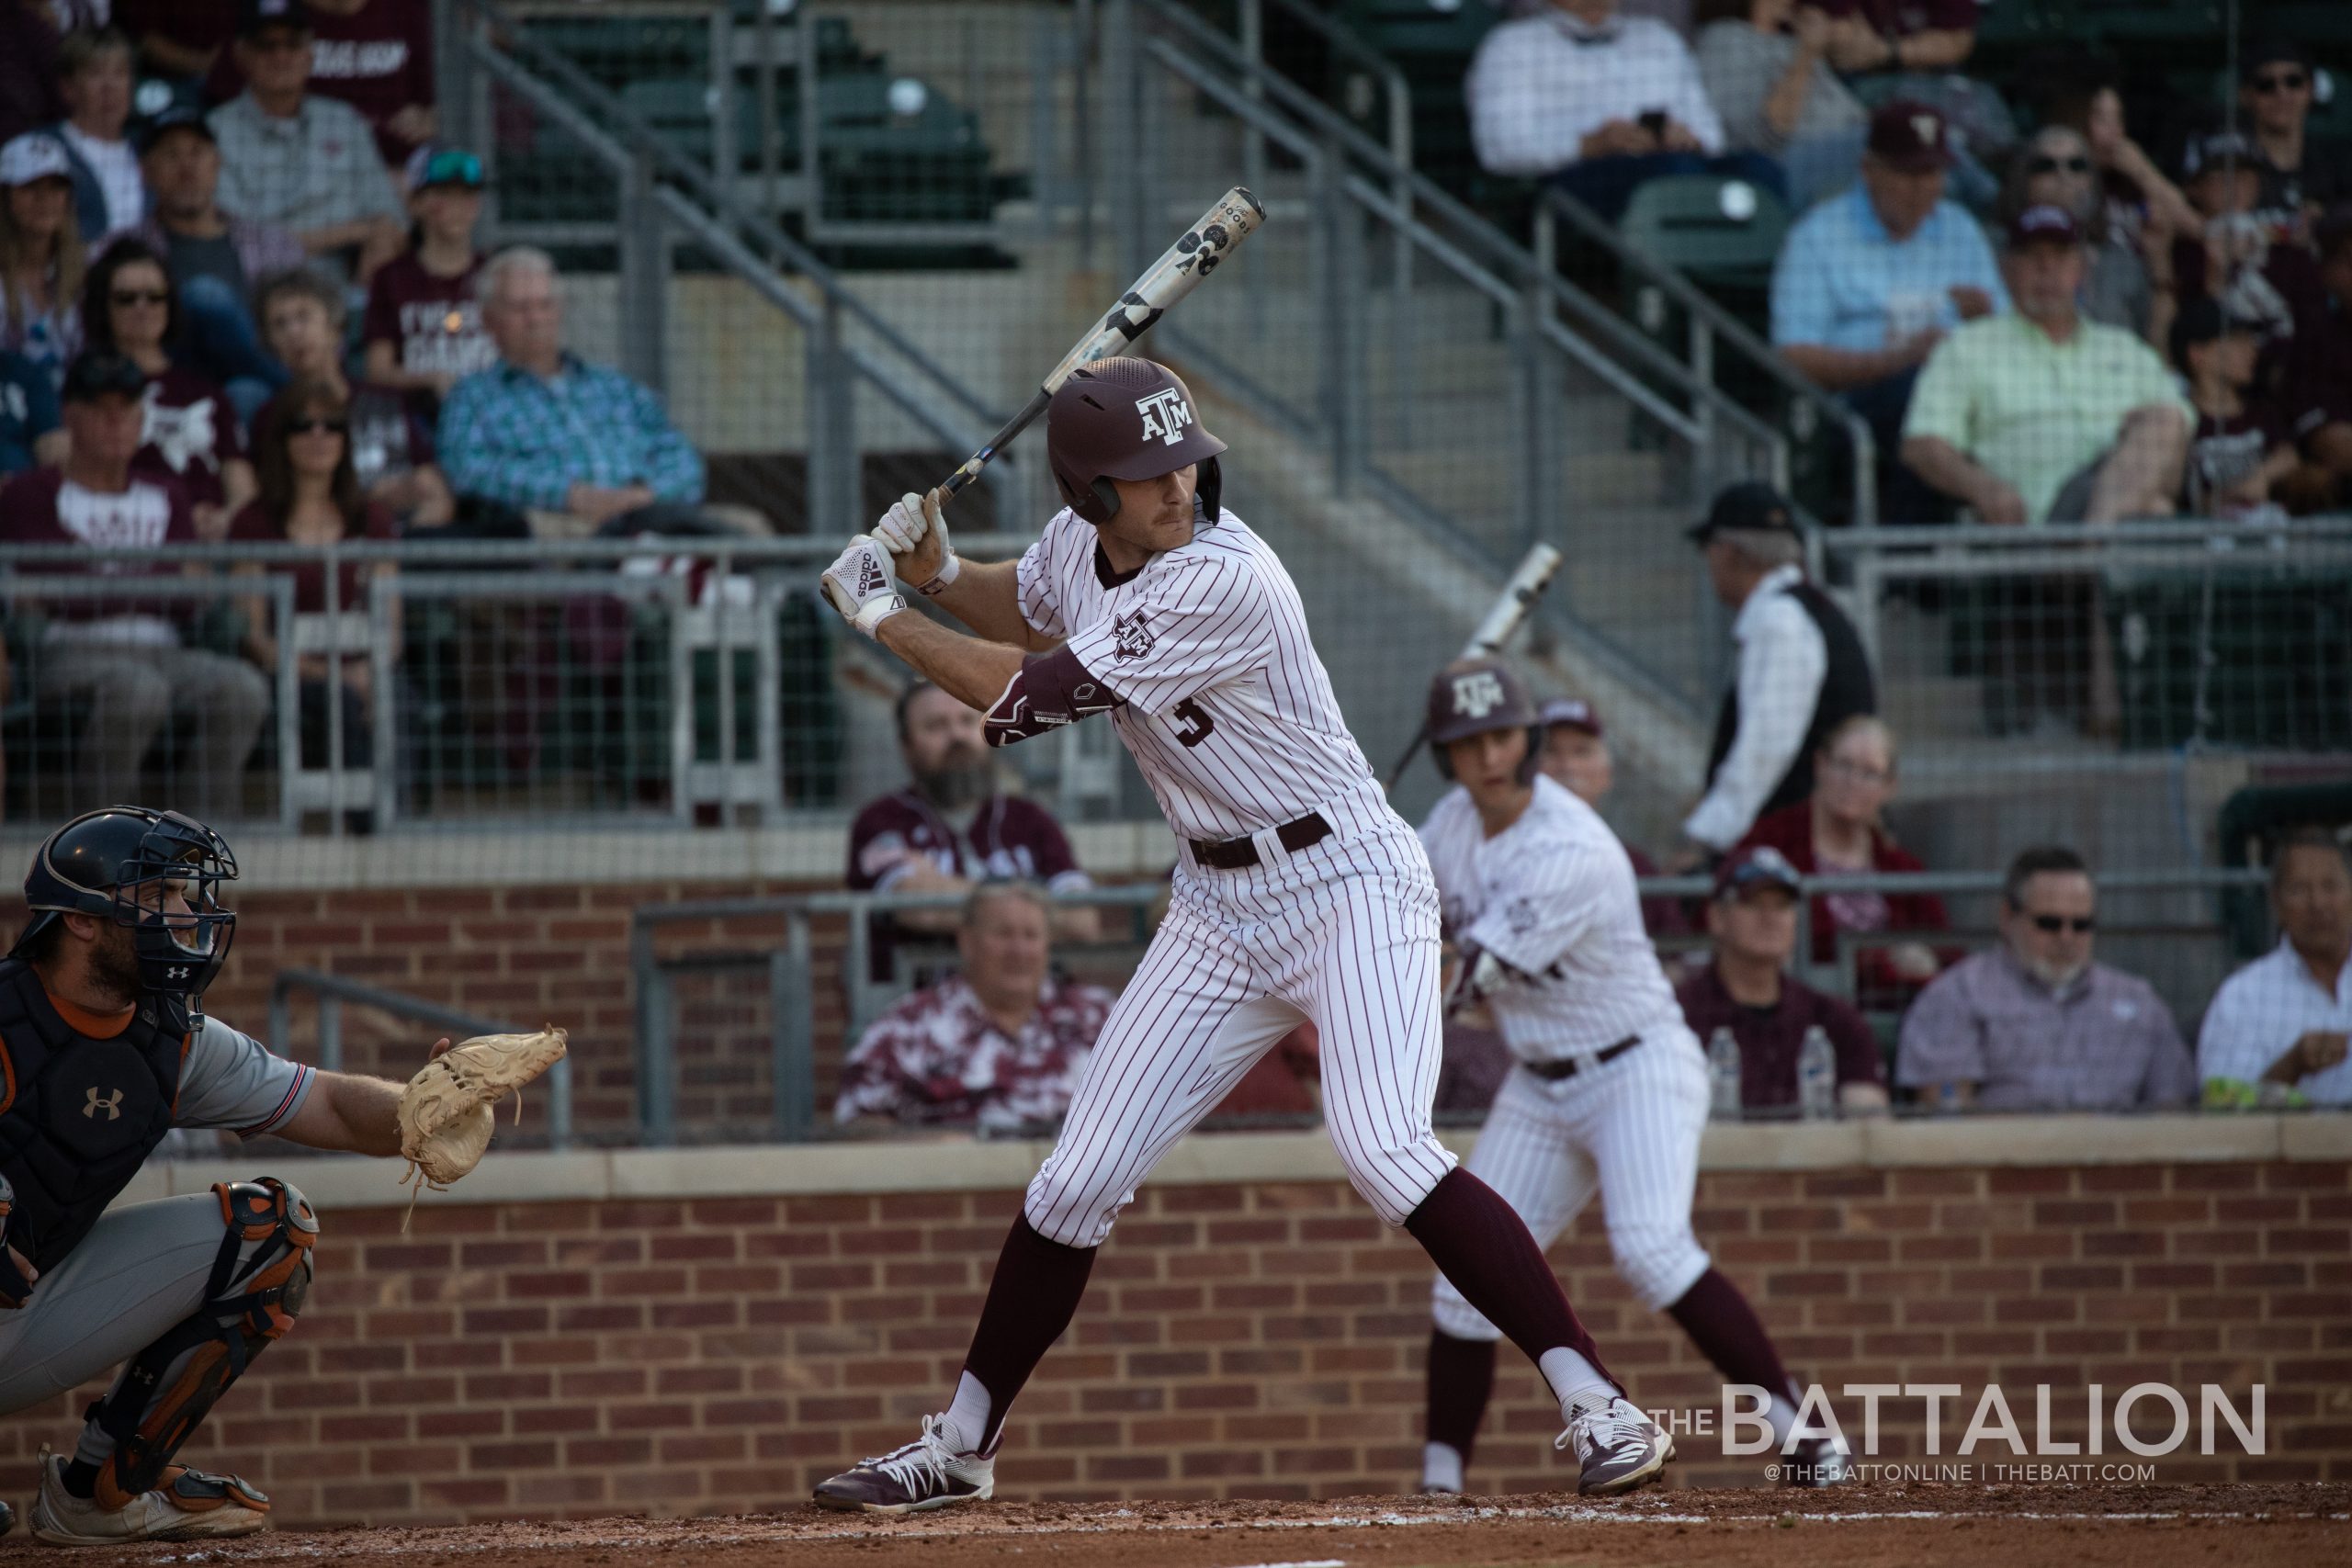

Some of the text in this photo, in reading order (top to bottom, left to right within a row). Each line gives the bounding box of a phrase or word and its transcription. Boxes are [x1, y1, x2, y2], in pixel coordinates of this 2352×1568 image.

[1220, 202, 1250, 234] GOODS
[857, 552, 872, 598] adidas
[1173, 696, 1214, 748] 3
